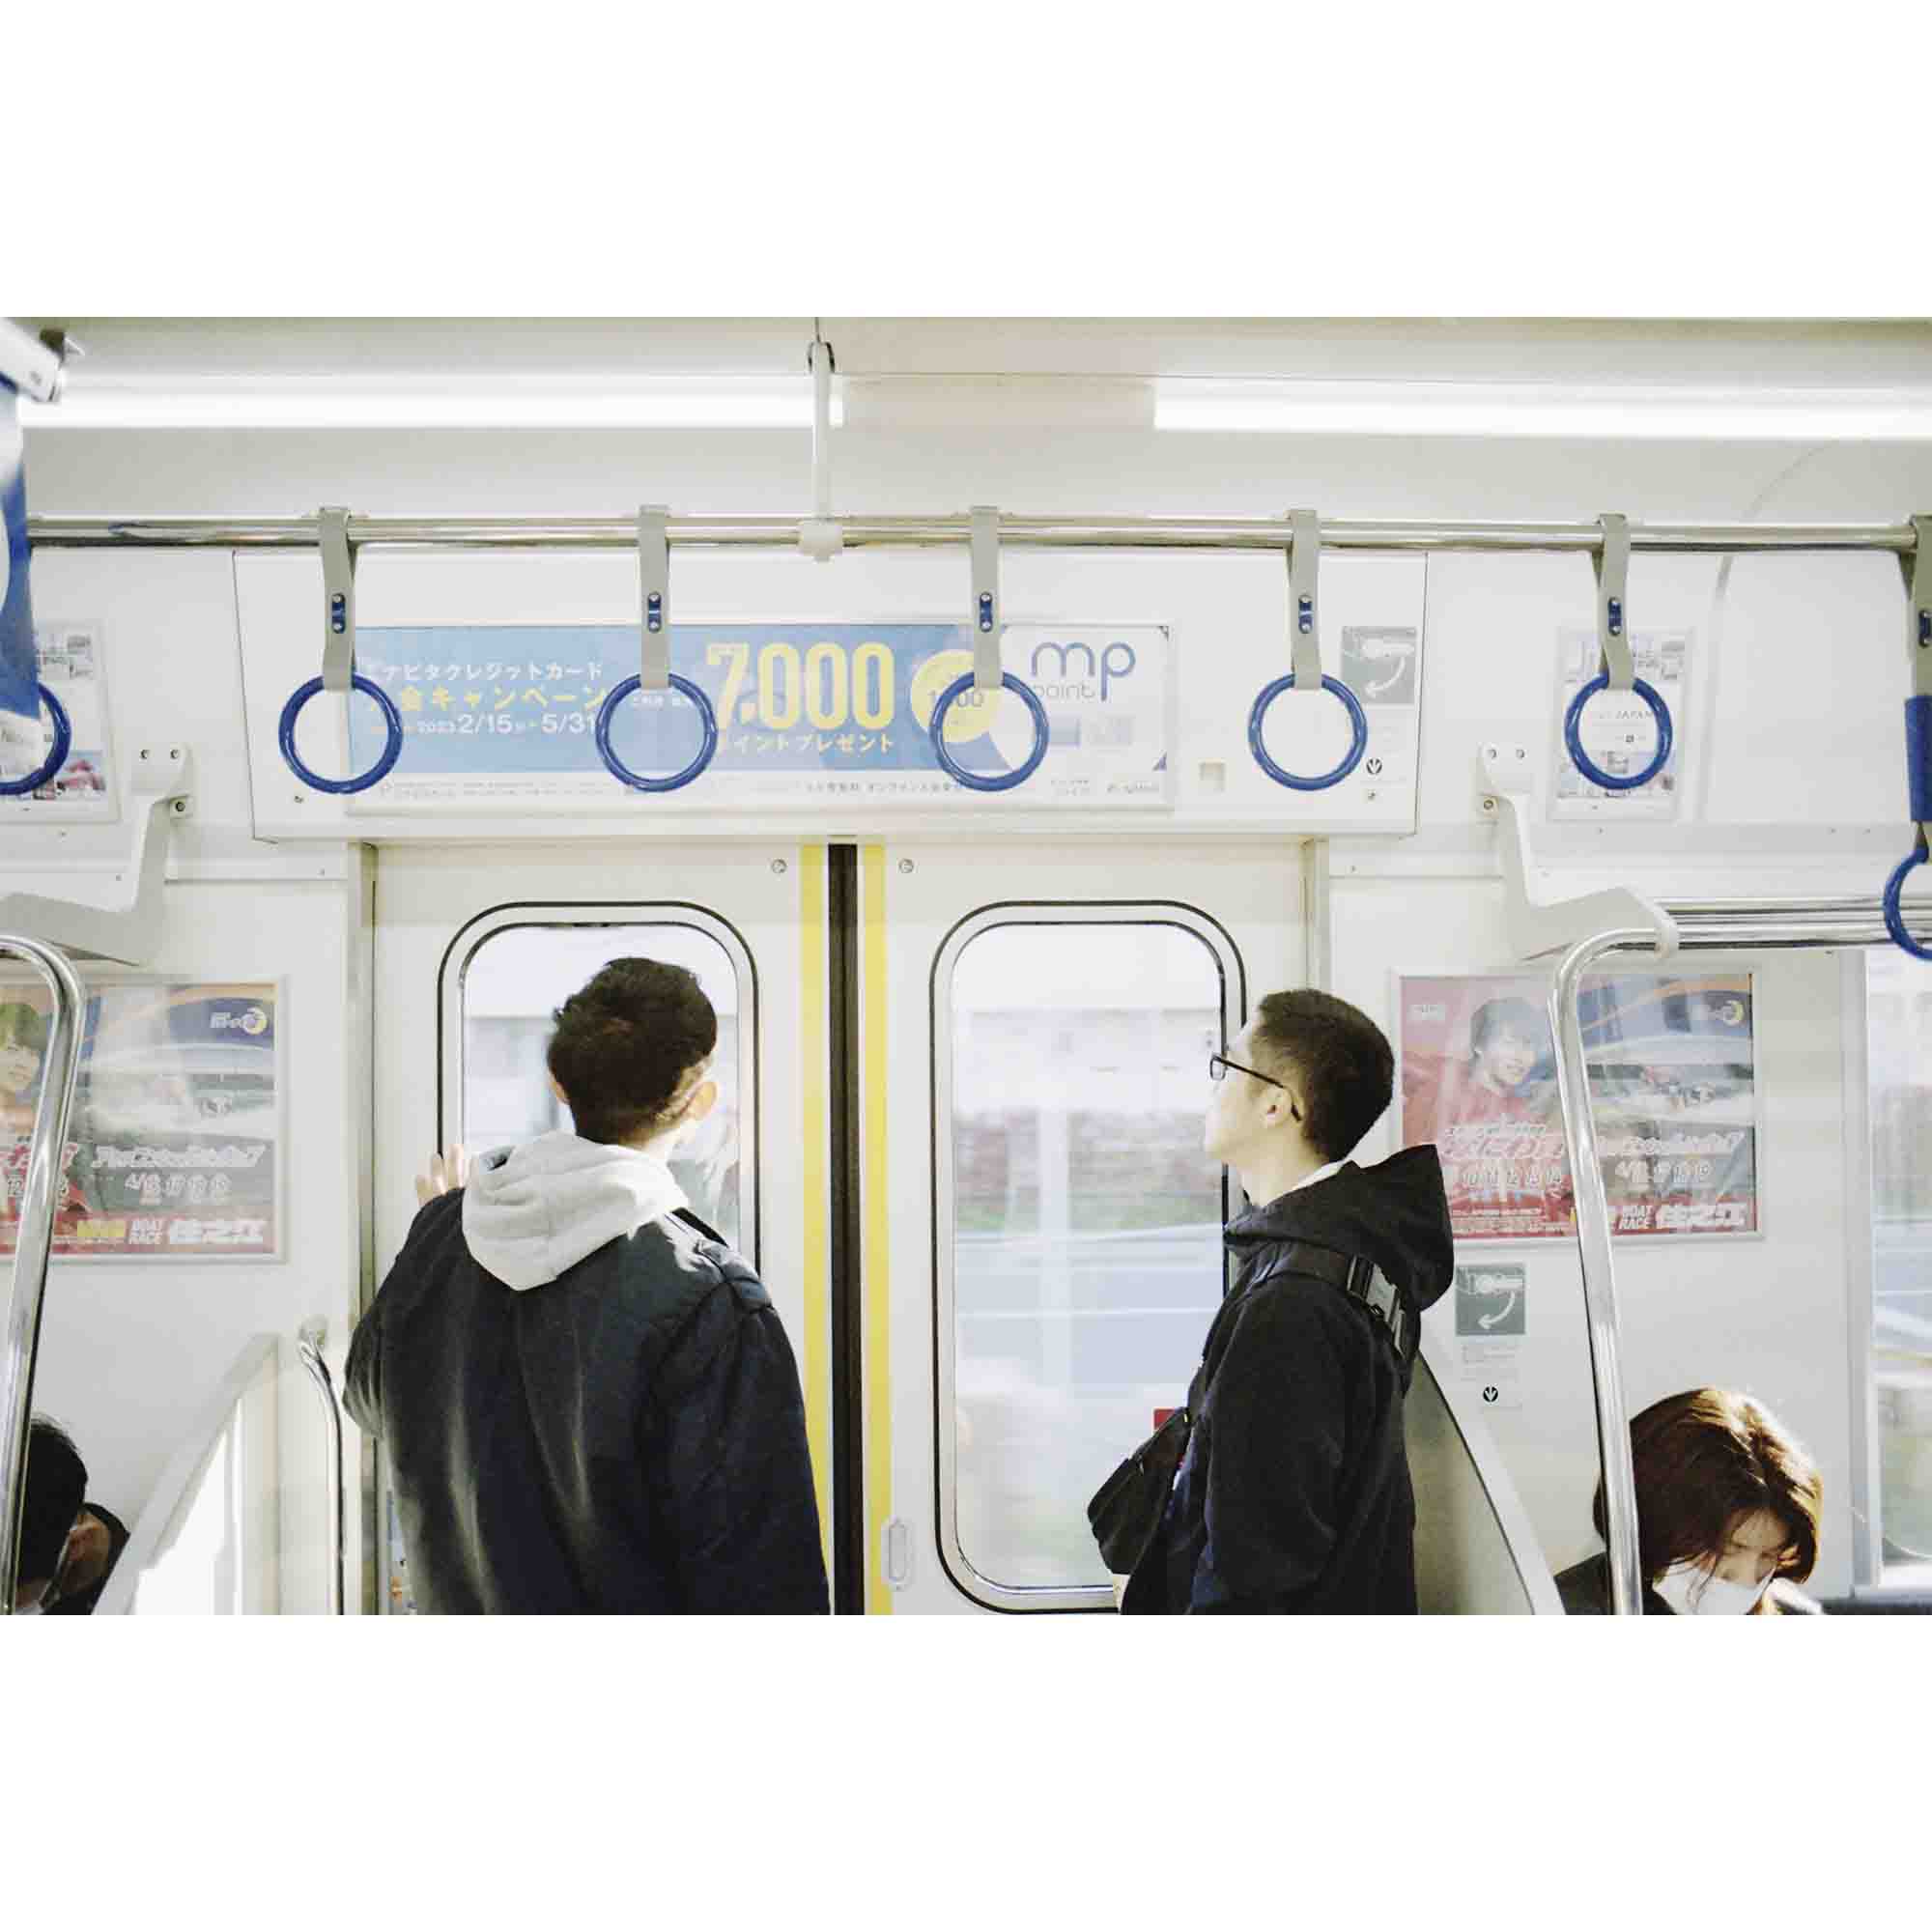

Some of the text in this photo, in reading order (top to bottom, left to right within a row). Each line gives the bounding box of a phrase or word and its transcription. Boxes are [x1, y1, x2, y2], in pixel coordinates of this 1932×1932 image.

[1031, 641, 1136, 701] mp
[371, 684, 608, 711] 会キャンペーン
[457, 713, 513, 734] 2/15
